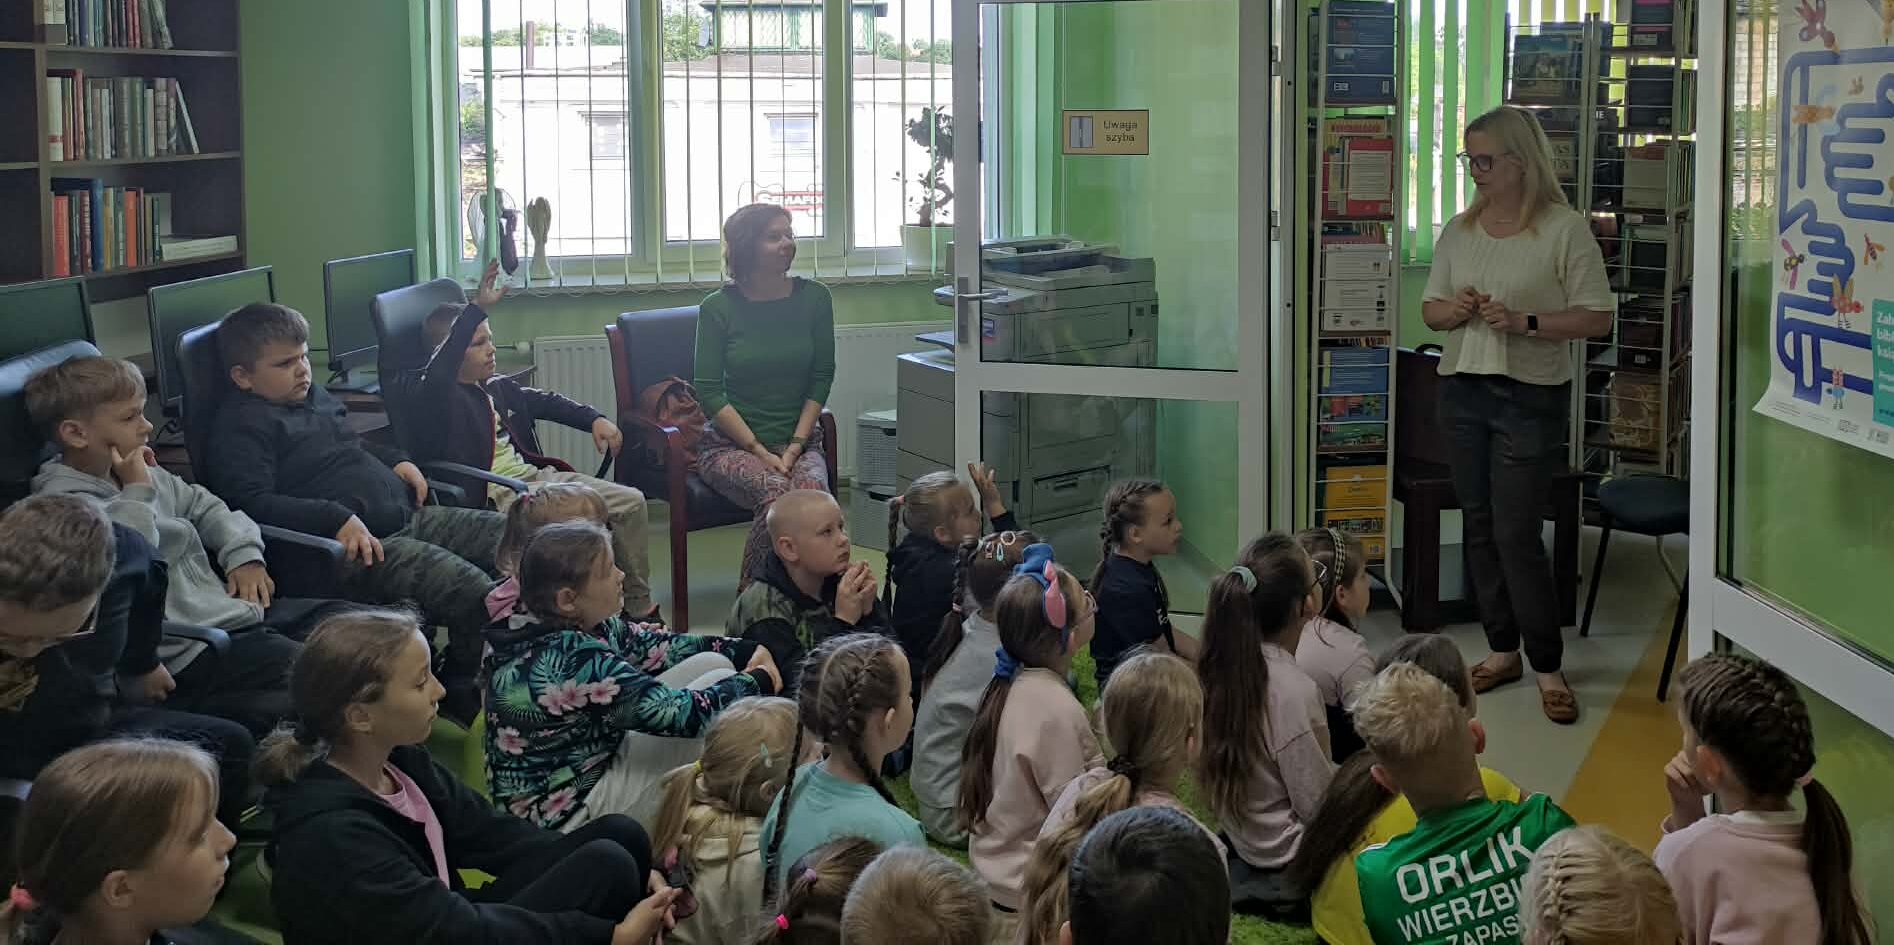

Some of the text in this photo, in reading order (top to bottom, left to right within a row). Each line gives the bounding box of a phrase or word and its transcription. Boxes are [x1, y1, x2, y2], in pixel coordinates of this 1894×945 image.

[1103, 120, 1138, 132] Uwaga
[1105, 132, 1135, 144] szyba
[1396, 826, 1535, 904] ORLIK
[1397, 877, 1522, 942] WIERZBI
[1446, 913, 1521, 945] ZAPAS
